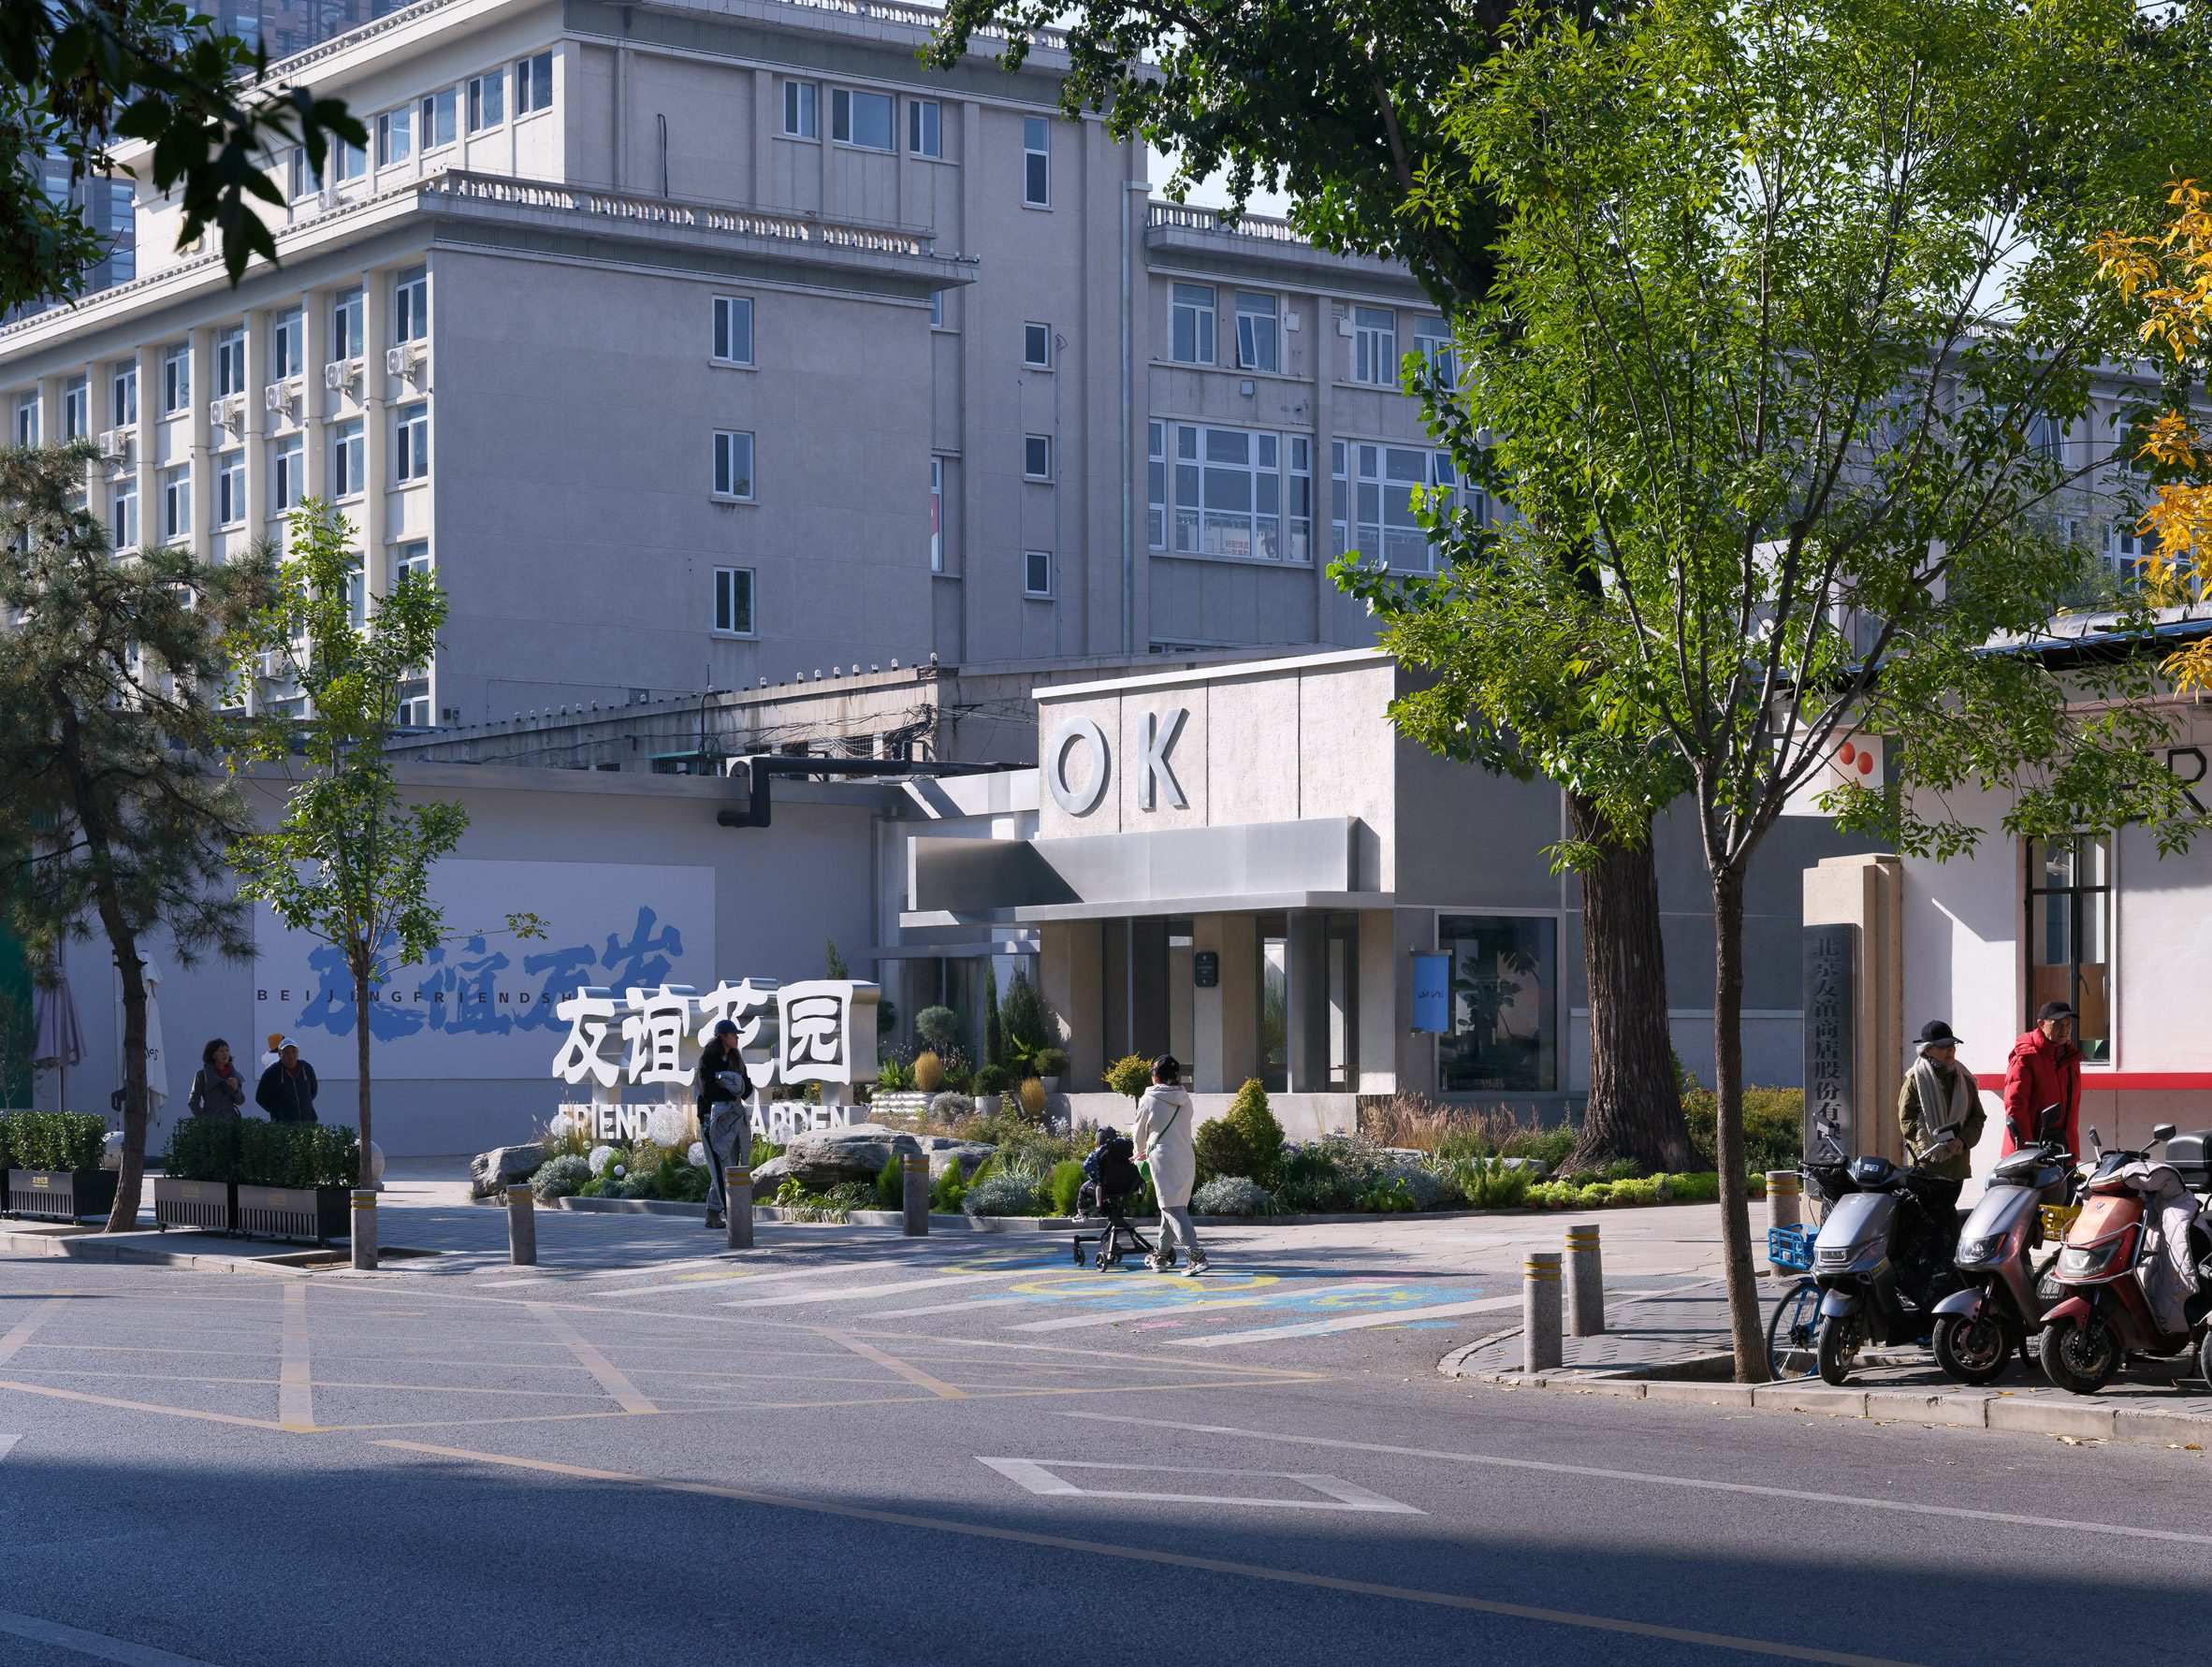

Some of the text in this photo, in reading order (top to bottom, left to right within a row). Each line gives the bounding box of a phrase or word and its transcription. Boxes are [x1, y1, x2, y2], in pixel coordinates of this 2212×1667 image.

[1048, 708, 1190, 817] OK
[552, 978, 854, 1088] 友谊花园
[742, 1103, 851, 1139] ARDEN
